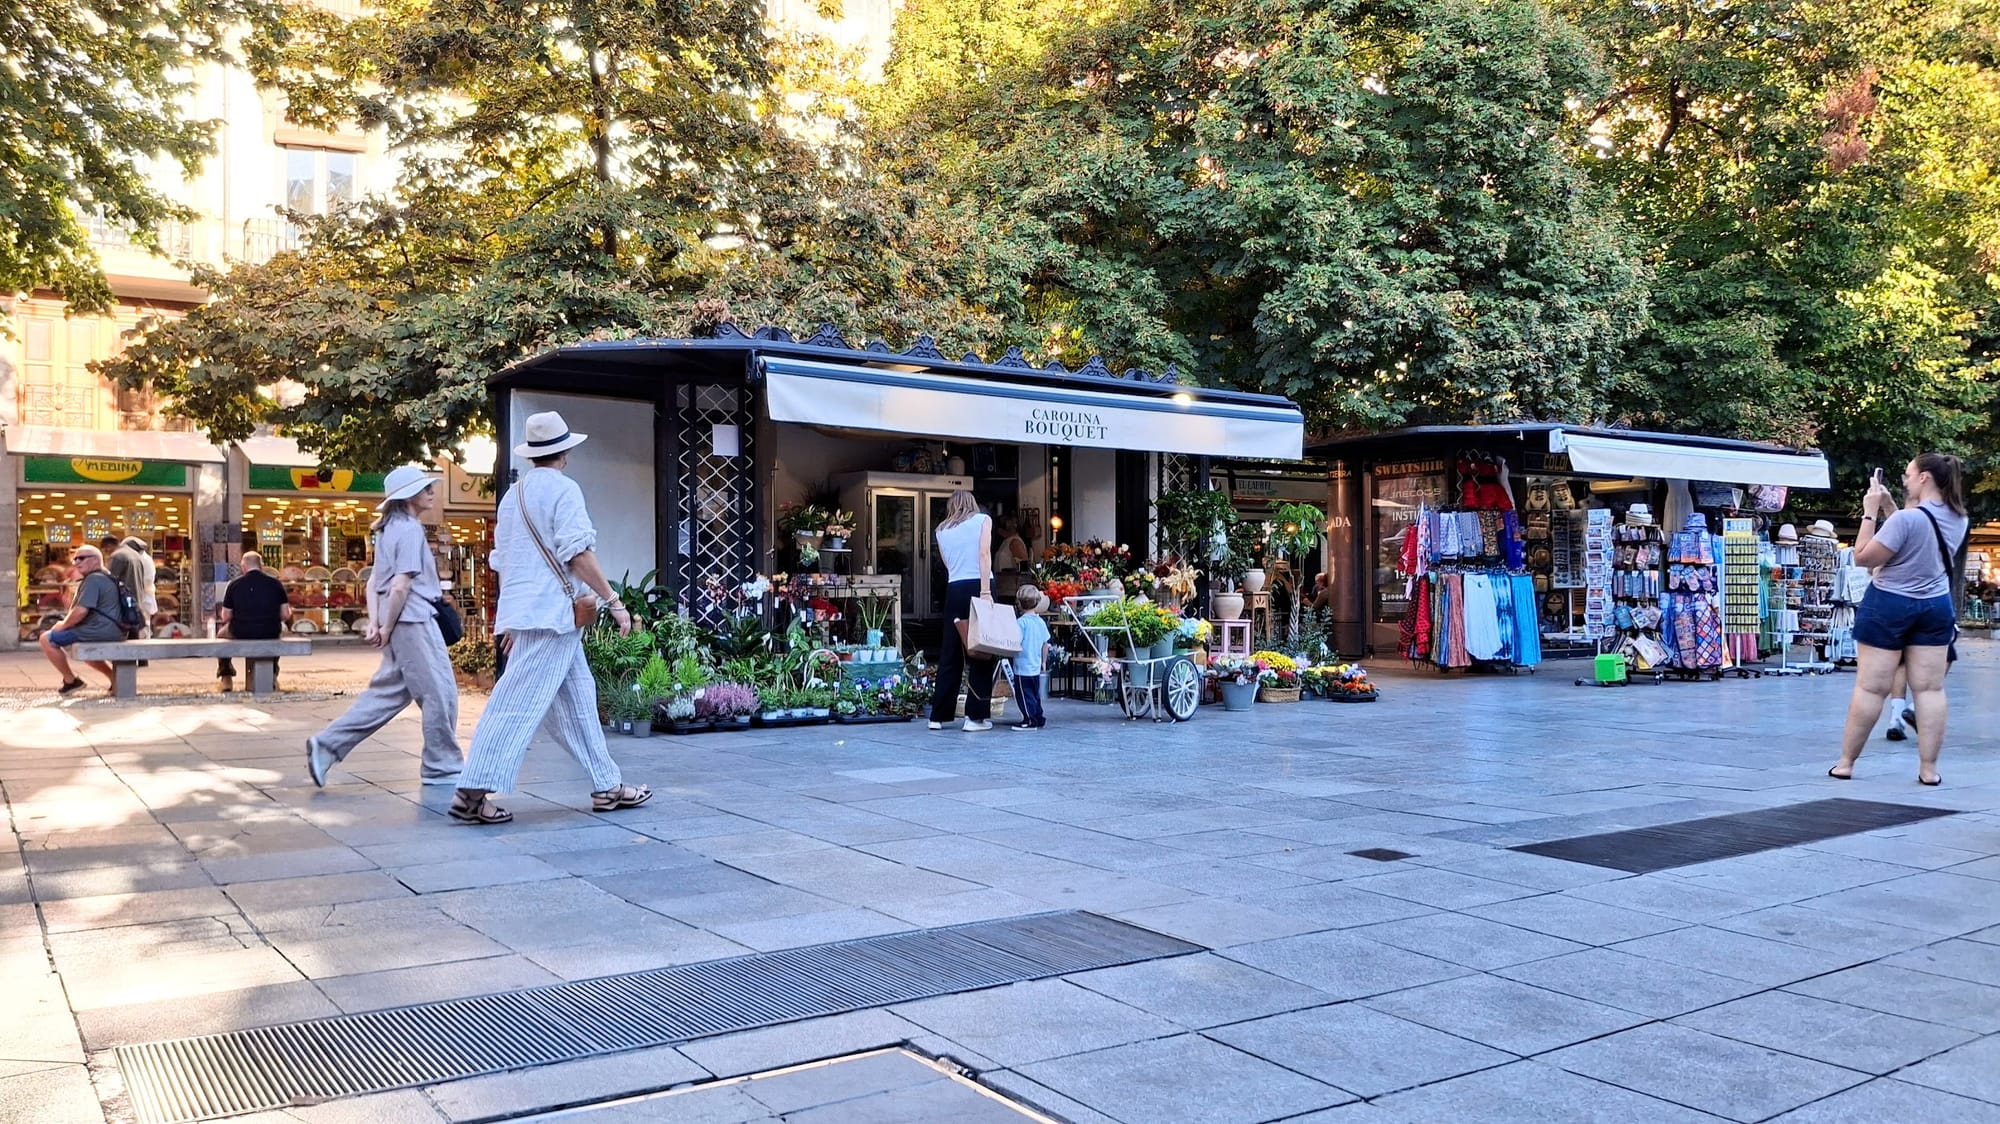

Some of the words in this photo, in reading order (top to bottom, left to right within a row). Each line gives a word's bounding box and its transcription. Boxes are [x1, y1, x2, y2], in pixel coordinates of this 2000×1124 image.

[1032, 408, 1101, 425] CAROLINA
[1025, 420, 1108, 441] BOUQUET
[87, 461, 138, 473] MEDINA
[1374, 460, 1444, 476] SWEATSHIR
